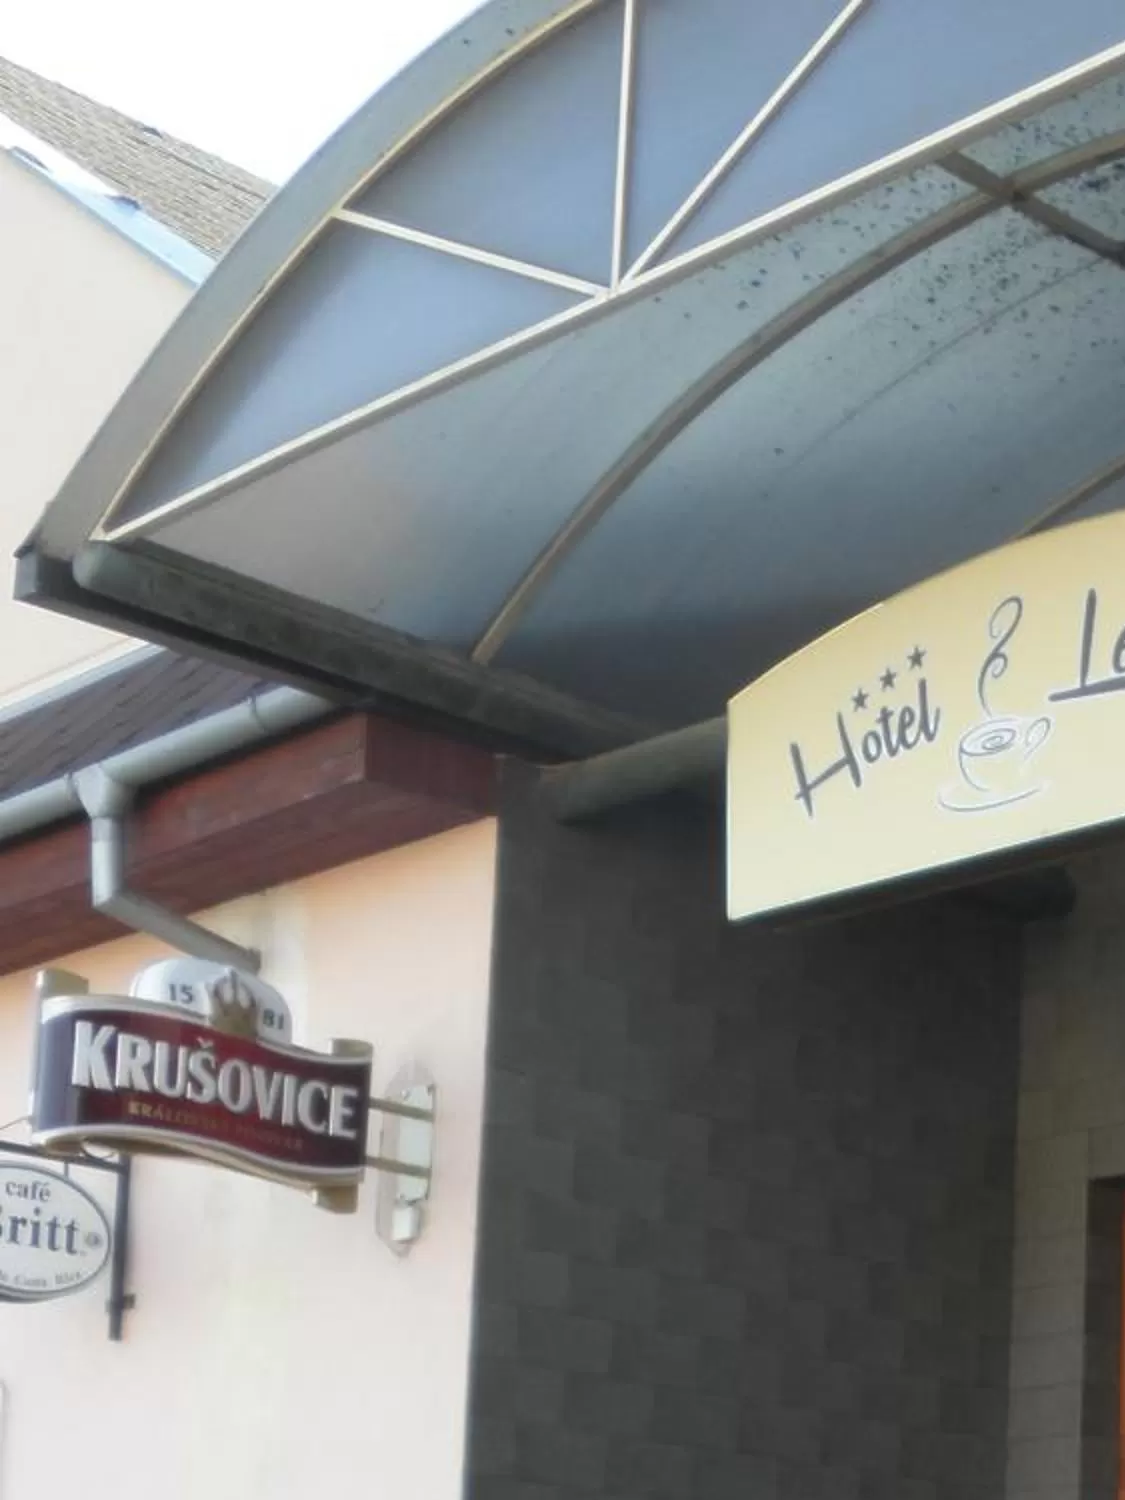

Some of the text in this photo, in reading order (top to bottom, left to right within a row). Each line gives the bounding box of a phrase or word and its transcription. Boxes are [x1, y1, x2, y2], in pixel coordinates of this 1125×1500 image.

[790, 678, 941, 818] Hotel
[168, 982, 285, 1031] 15 81
[71, 1019, 358, 1139] KRUŠOVICE
[5, 1181, 51, 1202] café
[0, 1205, 79, 1256] ritt
